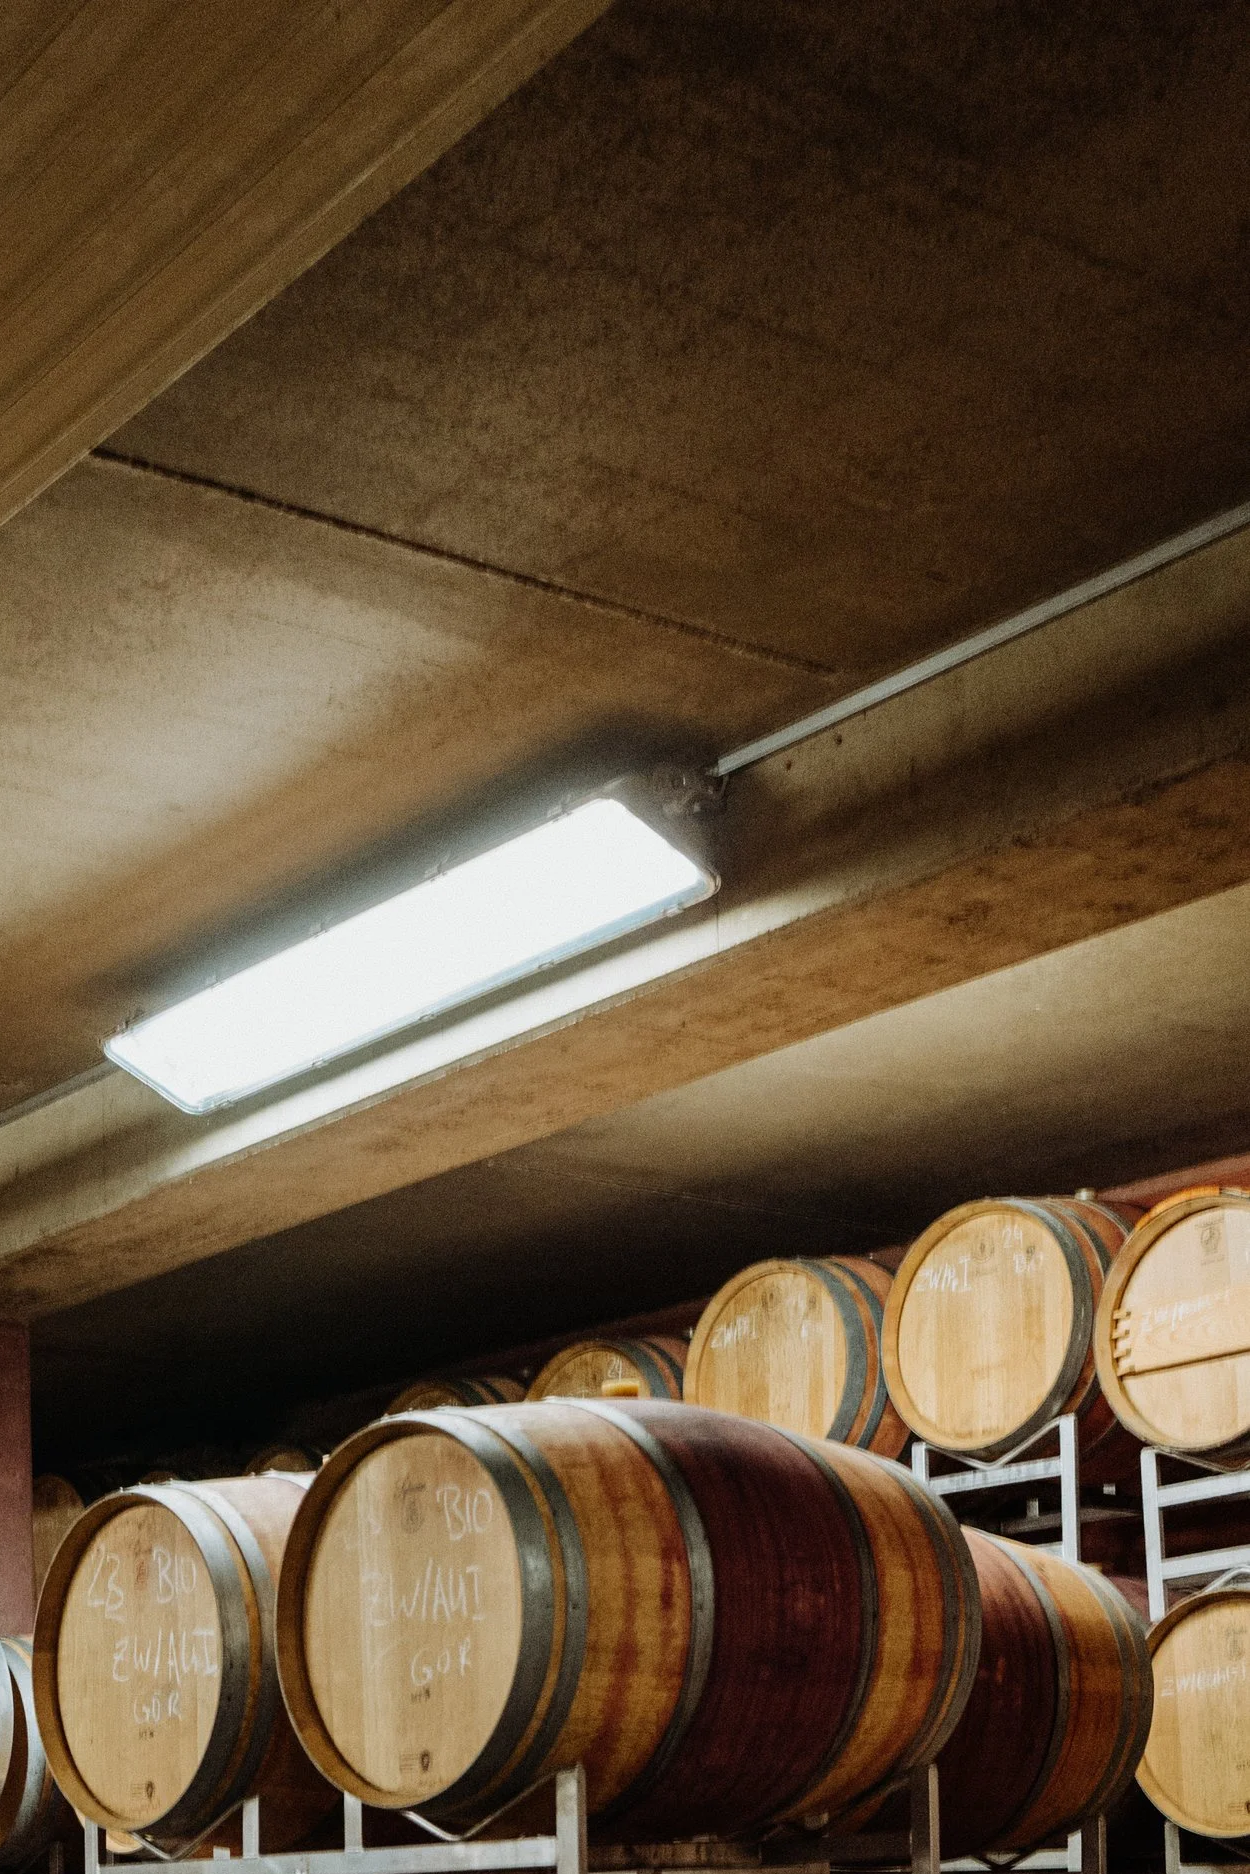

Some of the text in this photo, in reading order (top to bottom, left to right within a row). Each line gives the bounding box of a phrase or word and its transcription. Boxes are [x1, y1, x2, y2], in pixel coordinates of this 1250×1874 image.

[436, 1485, 493, 1542] BIO
[86, 1542, 198, 1624] 23 BIO
